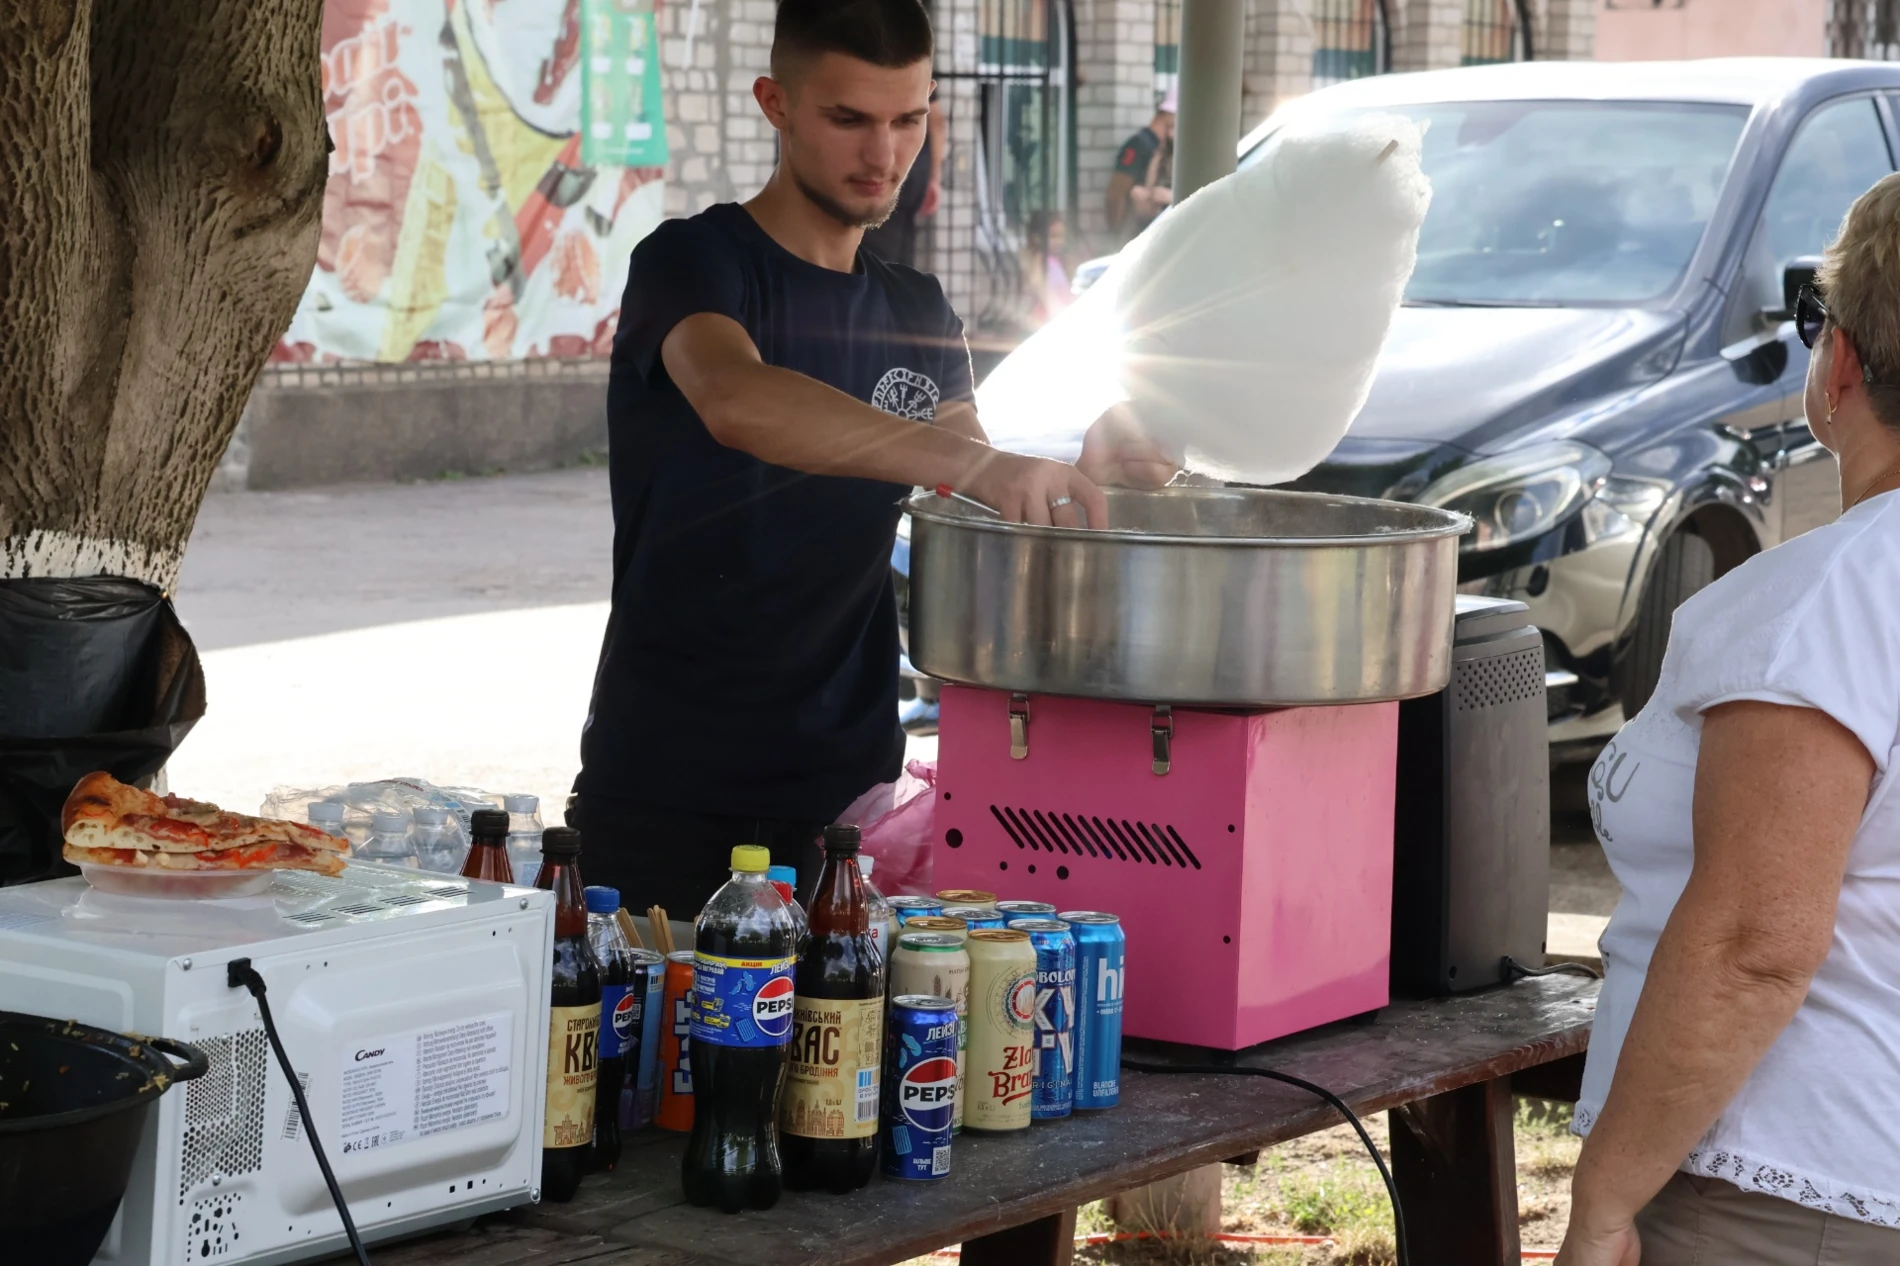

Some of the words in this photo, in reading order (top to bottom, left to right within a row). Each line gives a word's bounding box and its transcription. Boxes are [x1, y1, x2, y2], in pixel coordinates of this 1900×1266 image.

[615, 1011, 633, 1023] PEP
[1003, 1046, 1033, 1070] Zla
[800, 1066, 839, 1078] БРОДІННЯ
[903, 1084, 955, 1102] PEPS
